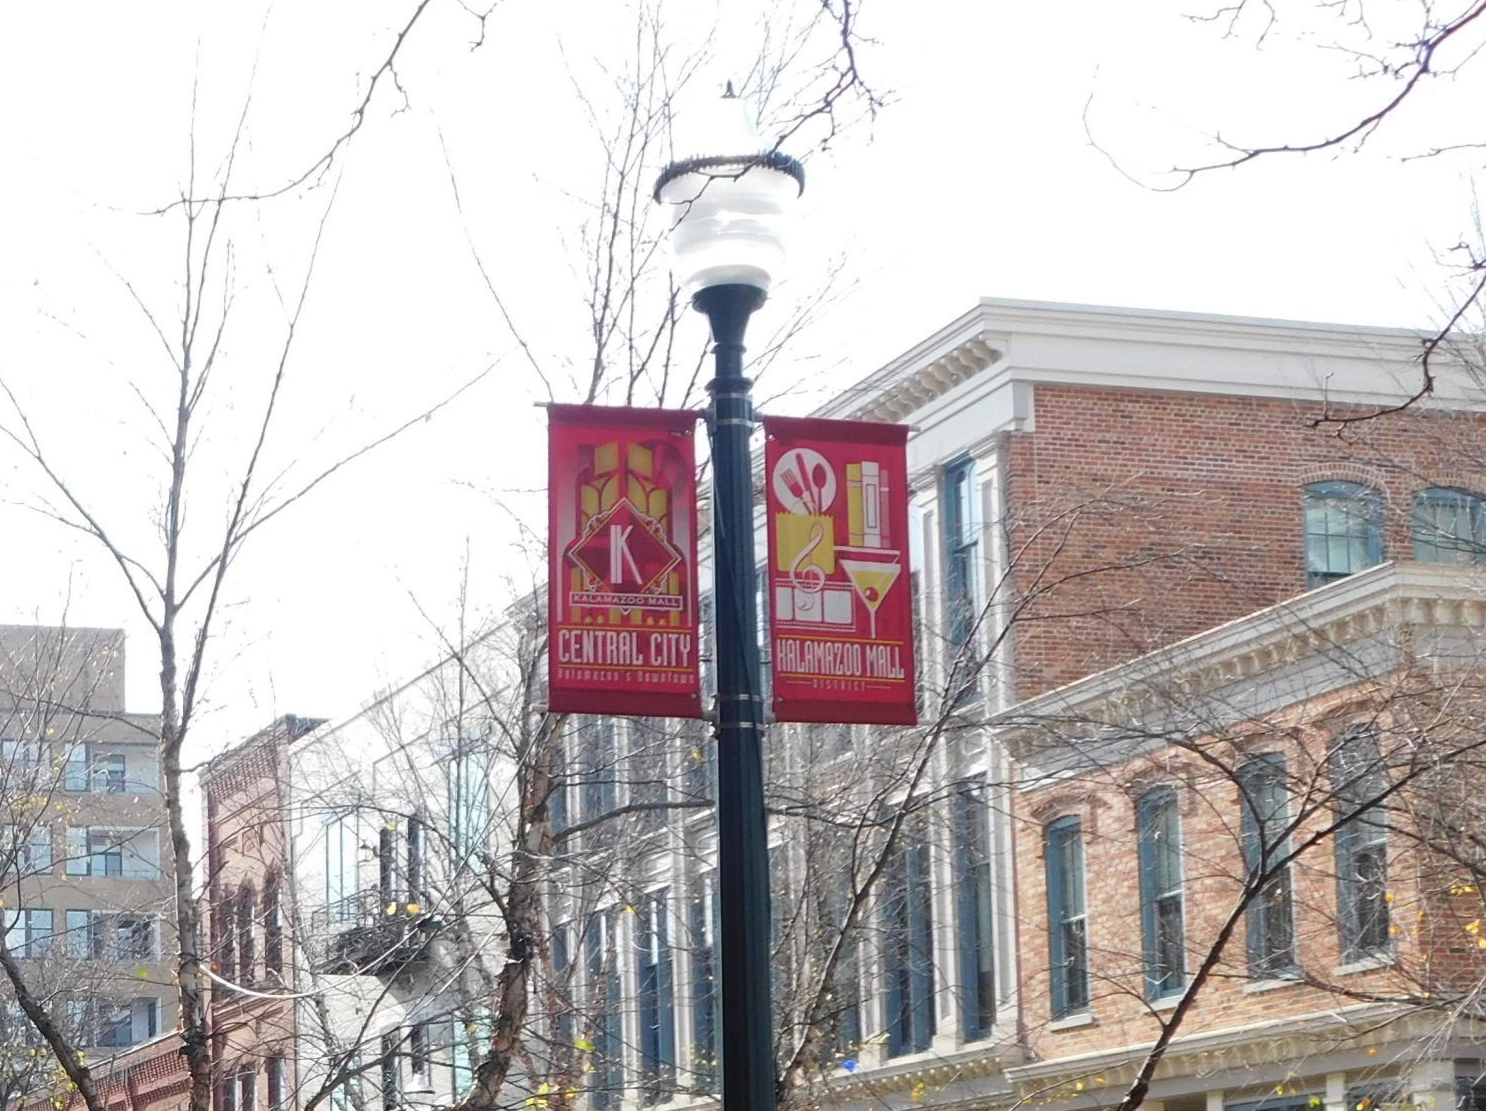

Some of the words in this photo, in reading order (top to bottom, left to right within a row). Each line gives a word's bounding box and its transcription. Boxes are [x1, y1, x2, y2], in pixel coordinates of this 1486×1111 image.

[610, 524, 643, 585] K
[573, 594, 644, 605] KALAMAZOO
[648, 597, 679, 607] MALL
[558, 629, 644, 666] CENTRAL
[650, 632, 691, 668] CITY
[777, 638, 863, 677] KALAMAZOO
[866, 644, 905, 679] MALL
